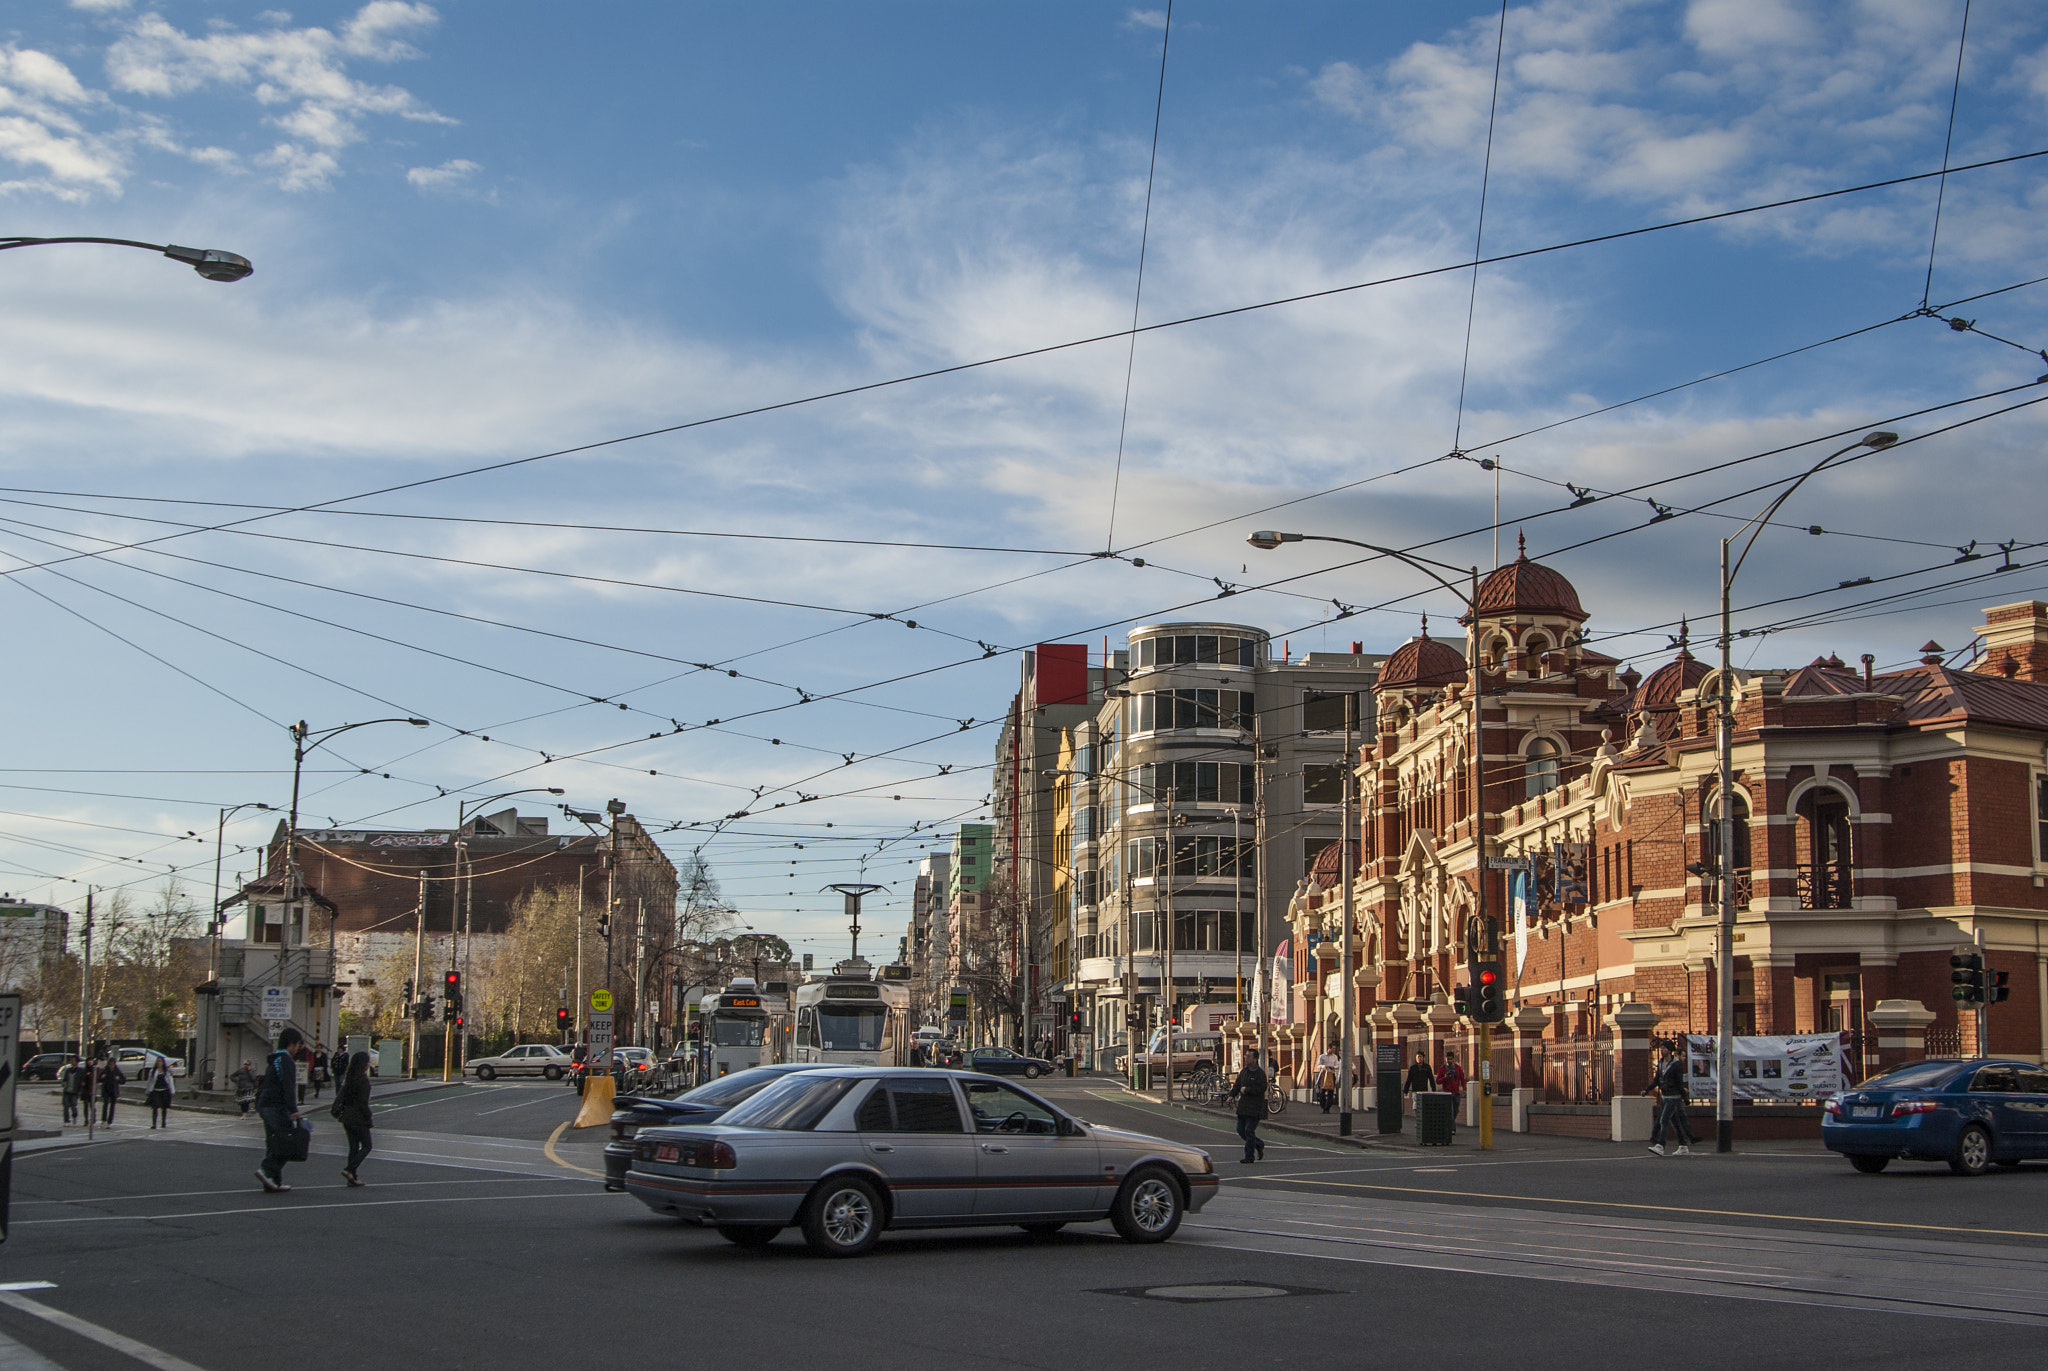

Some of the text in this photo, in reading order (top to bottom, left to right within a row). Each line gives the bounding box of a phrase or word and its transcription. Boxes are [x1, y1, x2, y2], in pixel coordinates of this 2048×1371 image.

[1490, 856, 1519, 865] FRANKLIN
[1272, 983, 1280, 1002] Shoe
[733, 998, 745, 1006] East
[590, 1021, 612, 1030] KEEP
[590, 1034, 611, 1043] LEFT
